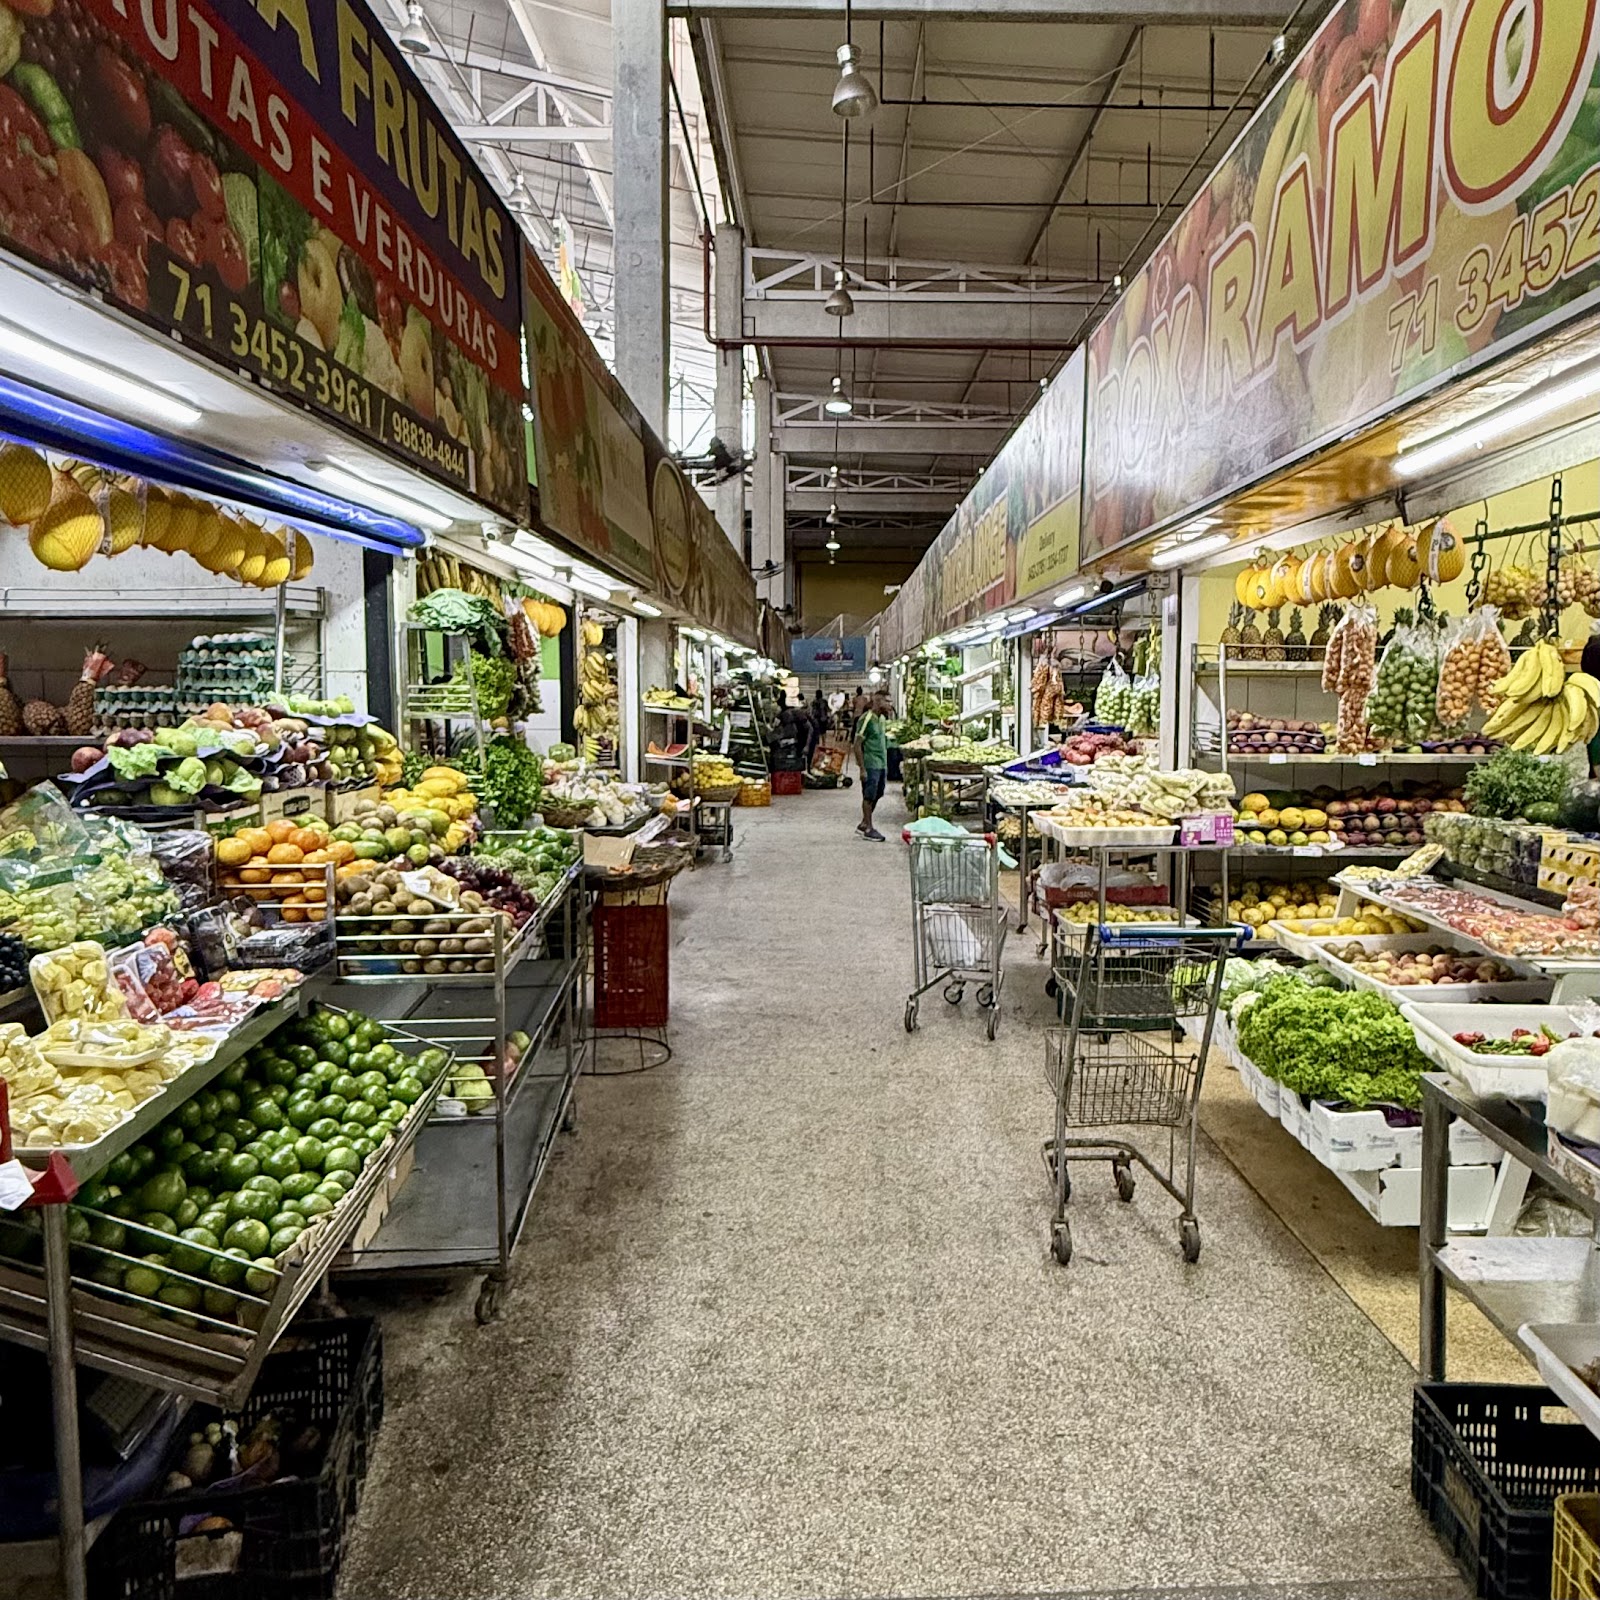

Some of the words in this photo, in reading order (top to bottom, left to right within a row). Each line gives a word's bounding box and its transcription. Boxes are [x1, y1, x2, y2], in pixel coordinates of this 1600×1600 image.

[311, 134, 334, 215] E
[347, 172, 498, 370] VERDURAS
[336, 0, 505, 299] FRUTAS
[168, 260, 213, 339] 71
[229, 301, 371, 429] 3452-3961
[392, 411, 466, 479] 98838-4844
[1094, 283, 1194, 500] BOX
[1388, 275, 1440, 376] 71
